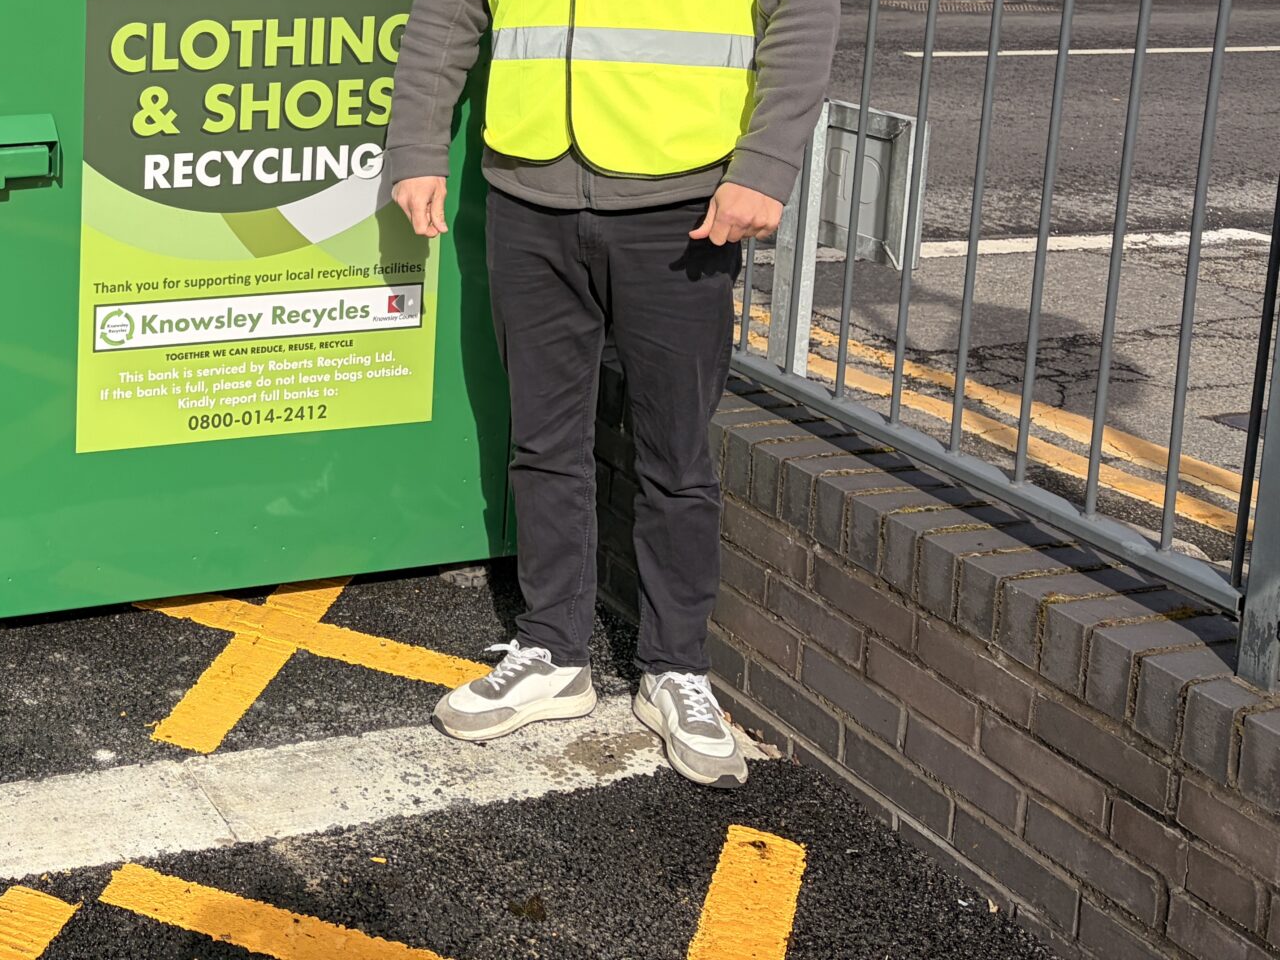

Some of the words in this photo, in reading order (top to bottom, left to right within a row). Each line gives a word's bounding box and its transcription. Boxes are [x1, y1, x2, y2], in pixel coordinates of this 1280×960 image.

[132, 85, 180, 137] &
[202, 76, 395, 134] SHOES
[143, 142, 384, 190] RECYCLING
[93, 280, 133, 294] Thank
[136, 280, 159, 294] you
[163, 277, 181, 289] for
[184, 273, 252, 290] supporting
[255, 272, 283, 285] your
[286, 268, 314, 281] local
[317, 265, 370, 280] recycling
[373, 262, 426, 275] facilities.
[141, 307, 263, 335] Knowsley
[271, 299, 370, 328] Recycles
[165, 351, 210, 361] TOGETHER
[213, 349, 227, 357] WE
[229, 347, 248, 356] CAN
[251, 344, 286, 354] REDUCE,
[288, 342, 317, 352] REUSE,
[319, 339, 354, 349] RECYCLE
[100, 388, 109, 401] If
[113, 388, 133, 399] the
[136, 384, 168, 398] bank
[172, 383, 182, 395] is
[185, 381, 209, 394] full,
[213, 379, 252, 394] please
[256, 375, 272, 387] do
[276, 374, 295, 386] not
[298, 372, 331, 384] leave
[334, 369, 363, 383] bags
[366, 365, 412, 379] outside.
[119, 371, 144, 384] This
[148, 368, 179, 381] bank
[183, 367, 193, 378] is
[196, 362, 246, 377] serviced
[250, 361, 265, 374] by
[268, 358, 313, 371] Roberts
[317, 353, 371, 369] Recycling
[375, 351, 396, 363] Ltd.
[177, 396, 216, 410] Kindly
[220, 393, 257, 407] report
[260, 390, 280, 402] full
[283, 387, 320, 400] banks
[323, 386, 339, 397] to:
[188, 404, 327, 431] 0800-014-2412
